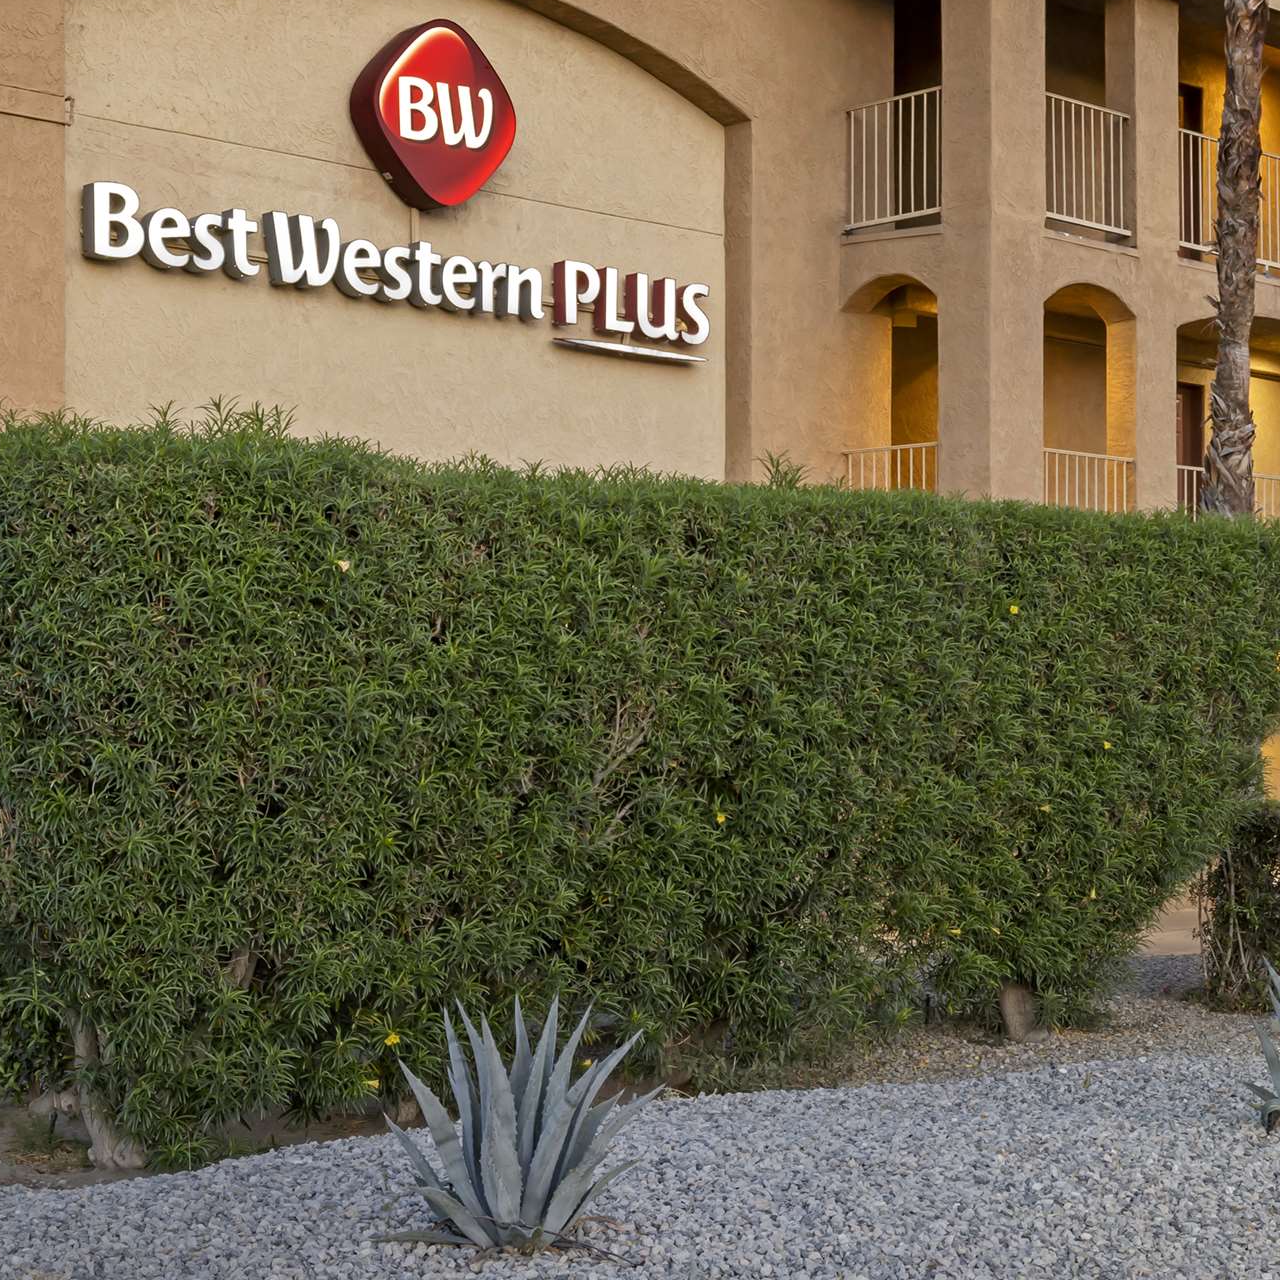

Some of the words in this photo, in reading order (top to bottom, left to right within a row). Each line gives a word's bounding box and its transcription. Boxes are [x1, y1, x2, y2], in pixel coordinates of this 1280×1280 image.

[398, 76, 493, 149] BW
[83, 181, 260, 278] Best
[265, 210, 545, 320] Western
[554, 259, 710, 347] PLUS
